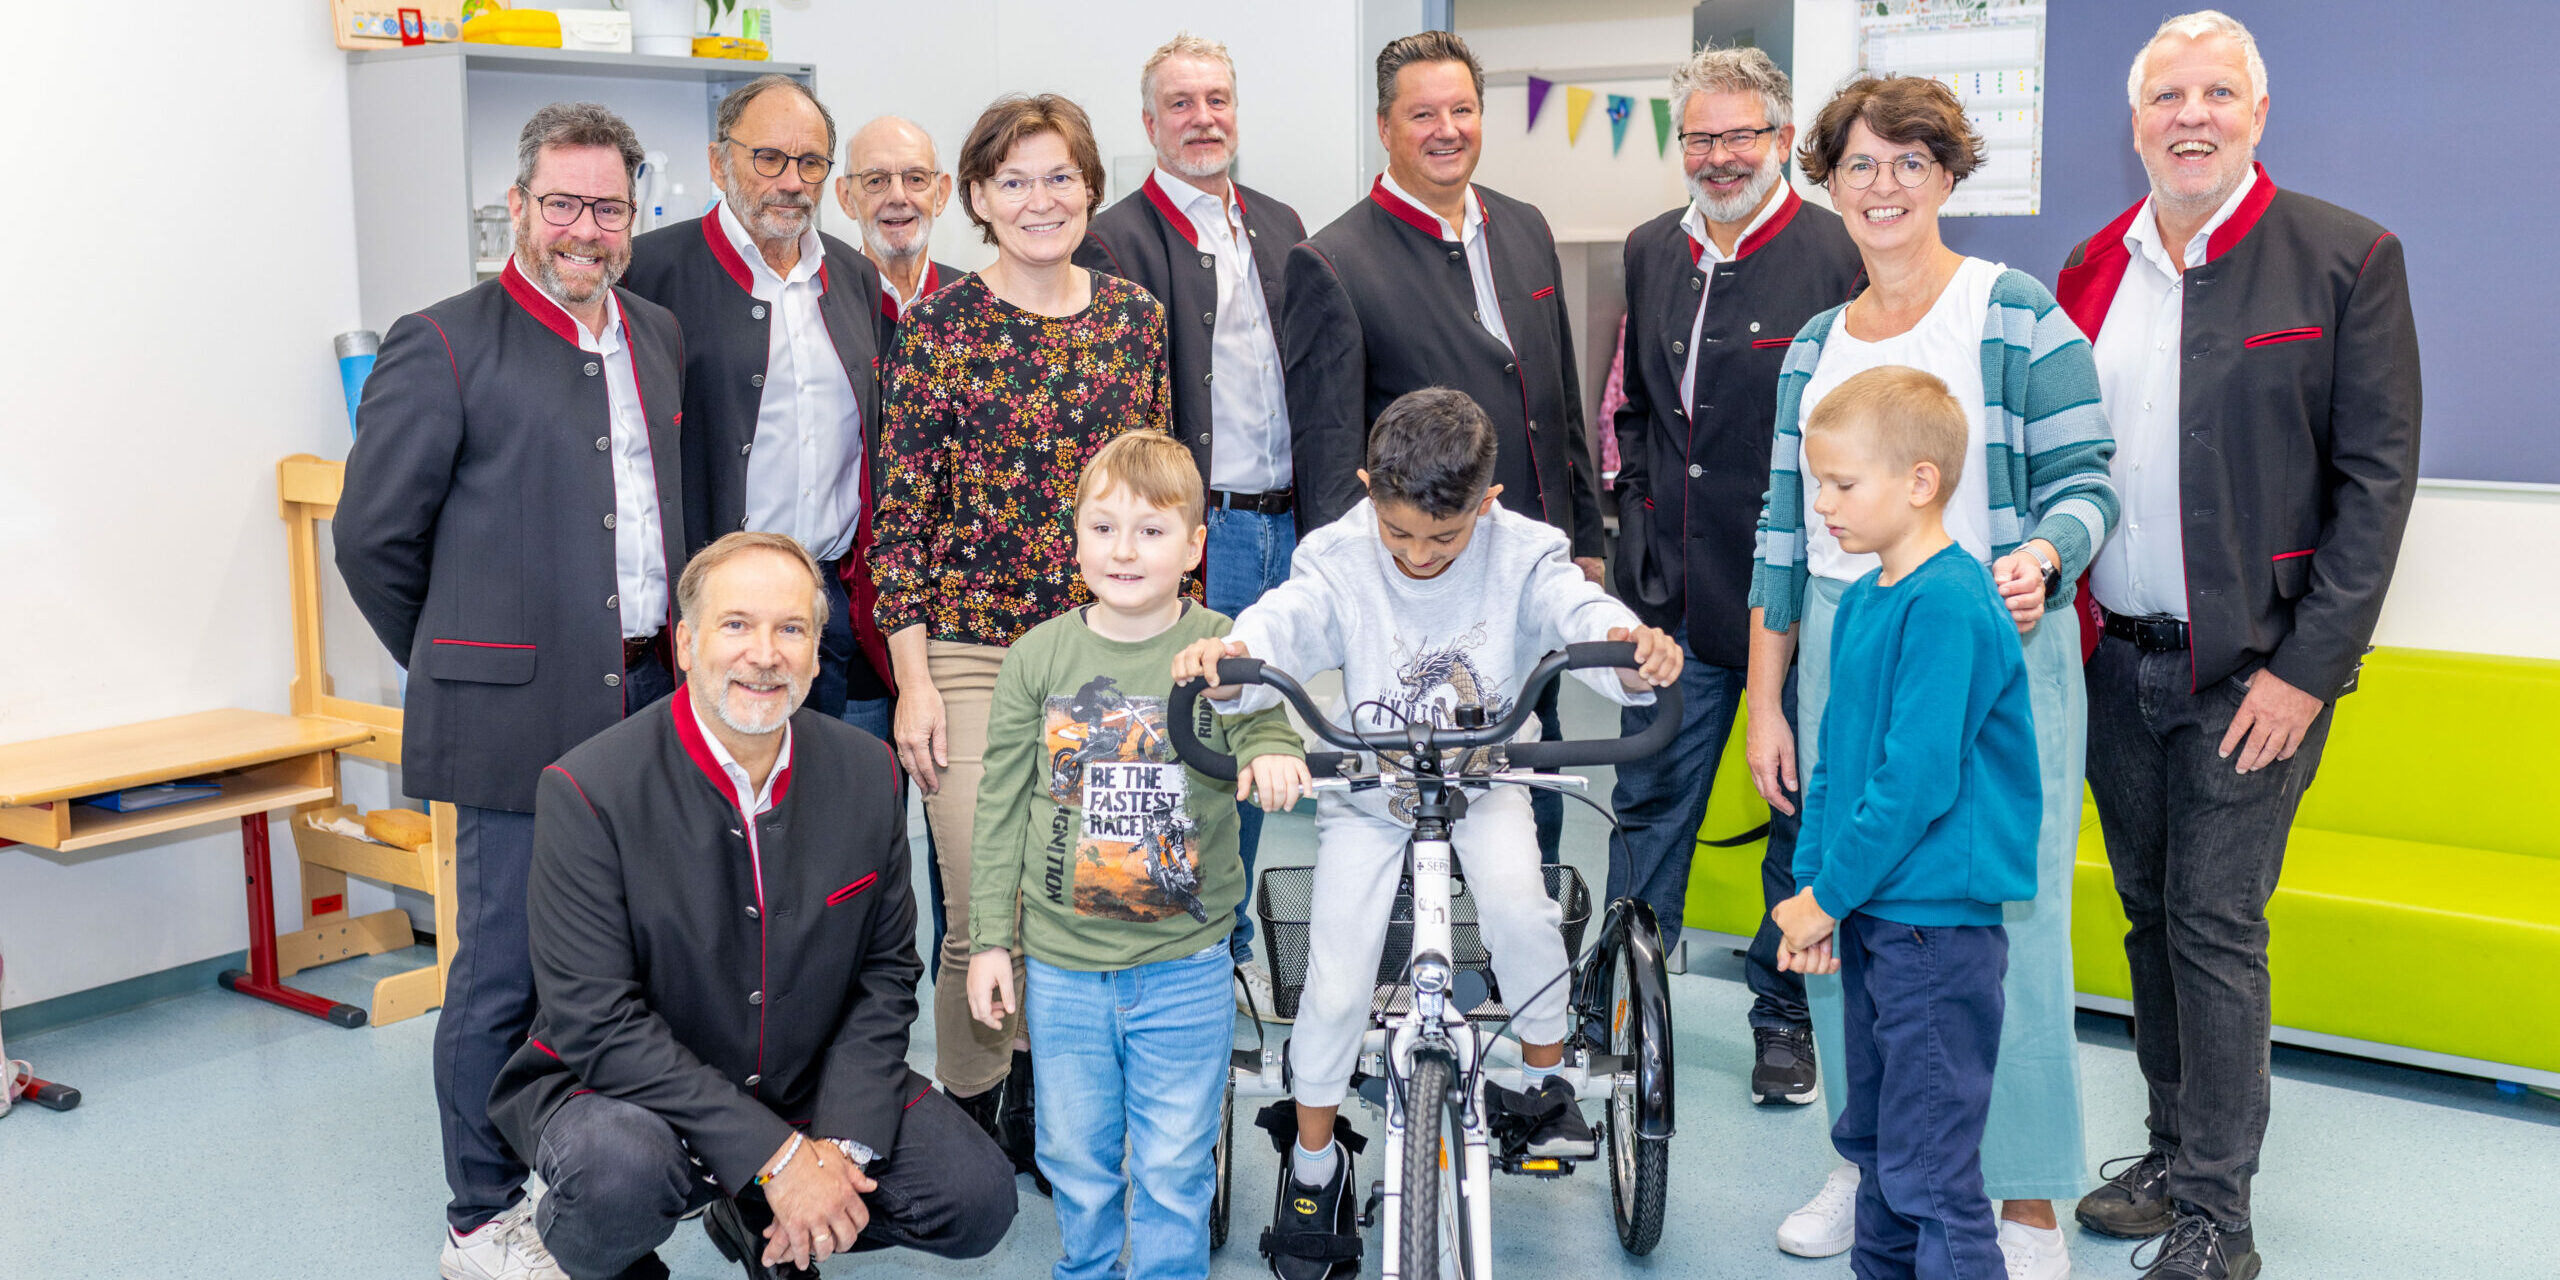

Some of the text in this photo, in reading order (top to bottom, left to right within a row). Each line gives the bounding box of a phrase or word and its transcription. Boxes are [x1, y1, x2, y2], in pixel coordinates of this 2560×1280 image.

[1091, 766, 1162, 789] BE THE
[1089, 790, 1180, 812] FASTEST
[1045, 807, 1071, 906] IGNITION
